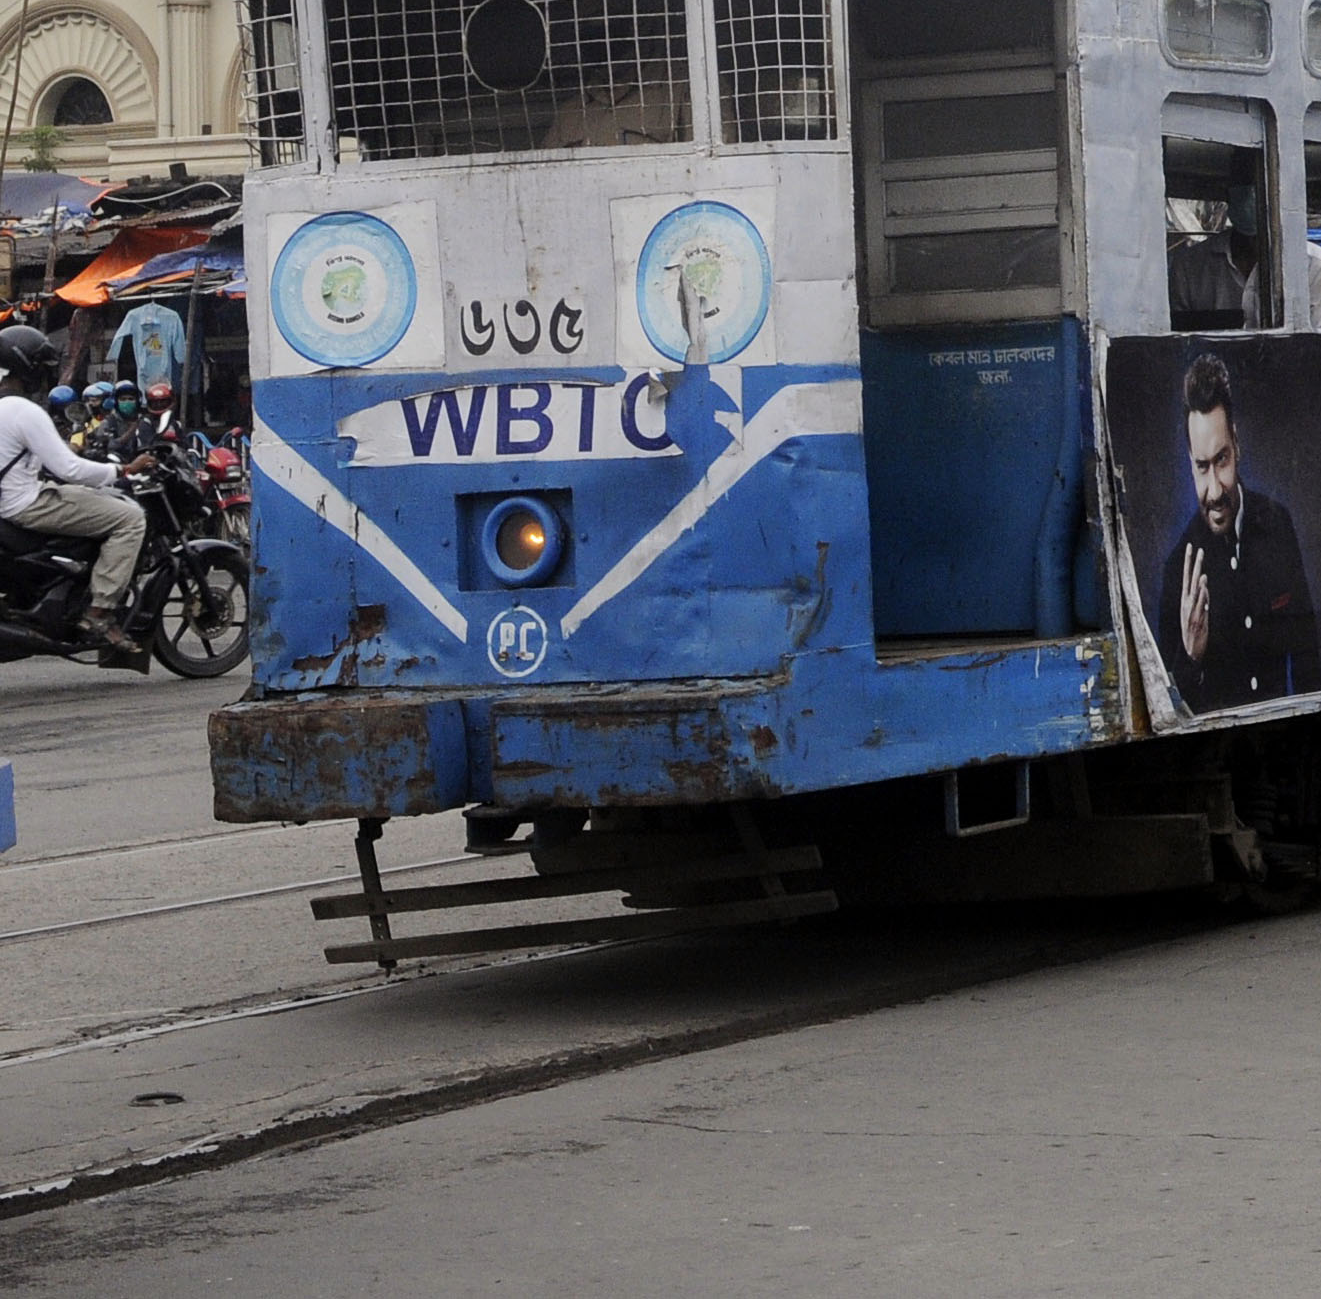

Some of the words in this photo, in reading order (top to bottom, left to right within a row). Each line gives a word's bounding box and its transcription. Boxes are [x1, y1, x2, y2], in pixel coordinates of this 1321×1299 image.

[461, 298, 584, 356] ৬৩৫
[401, 372, 674, 457] WBTC
[499, 622, 536, 661] PC
